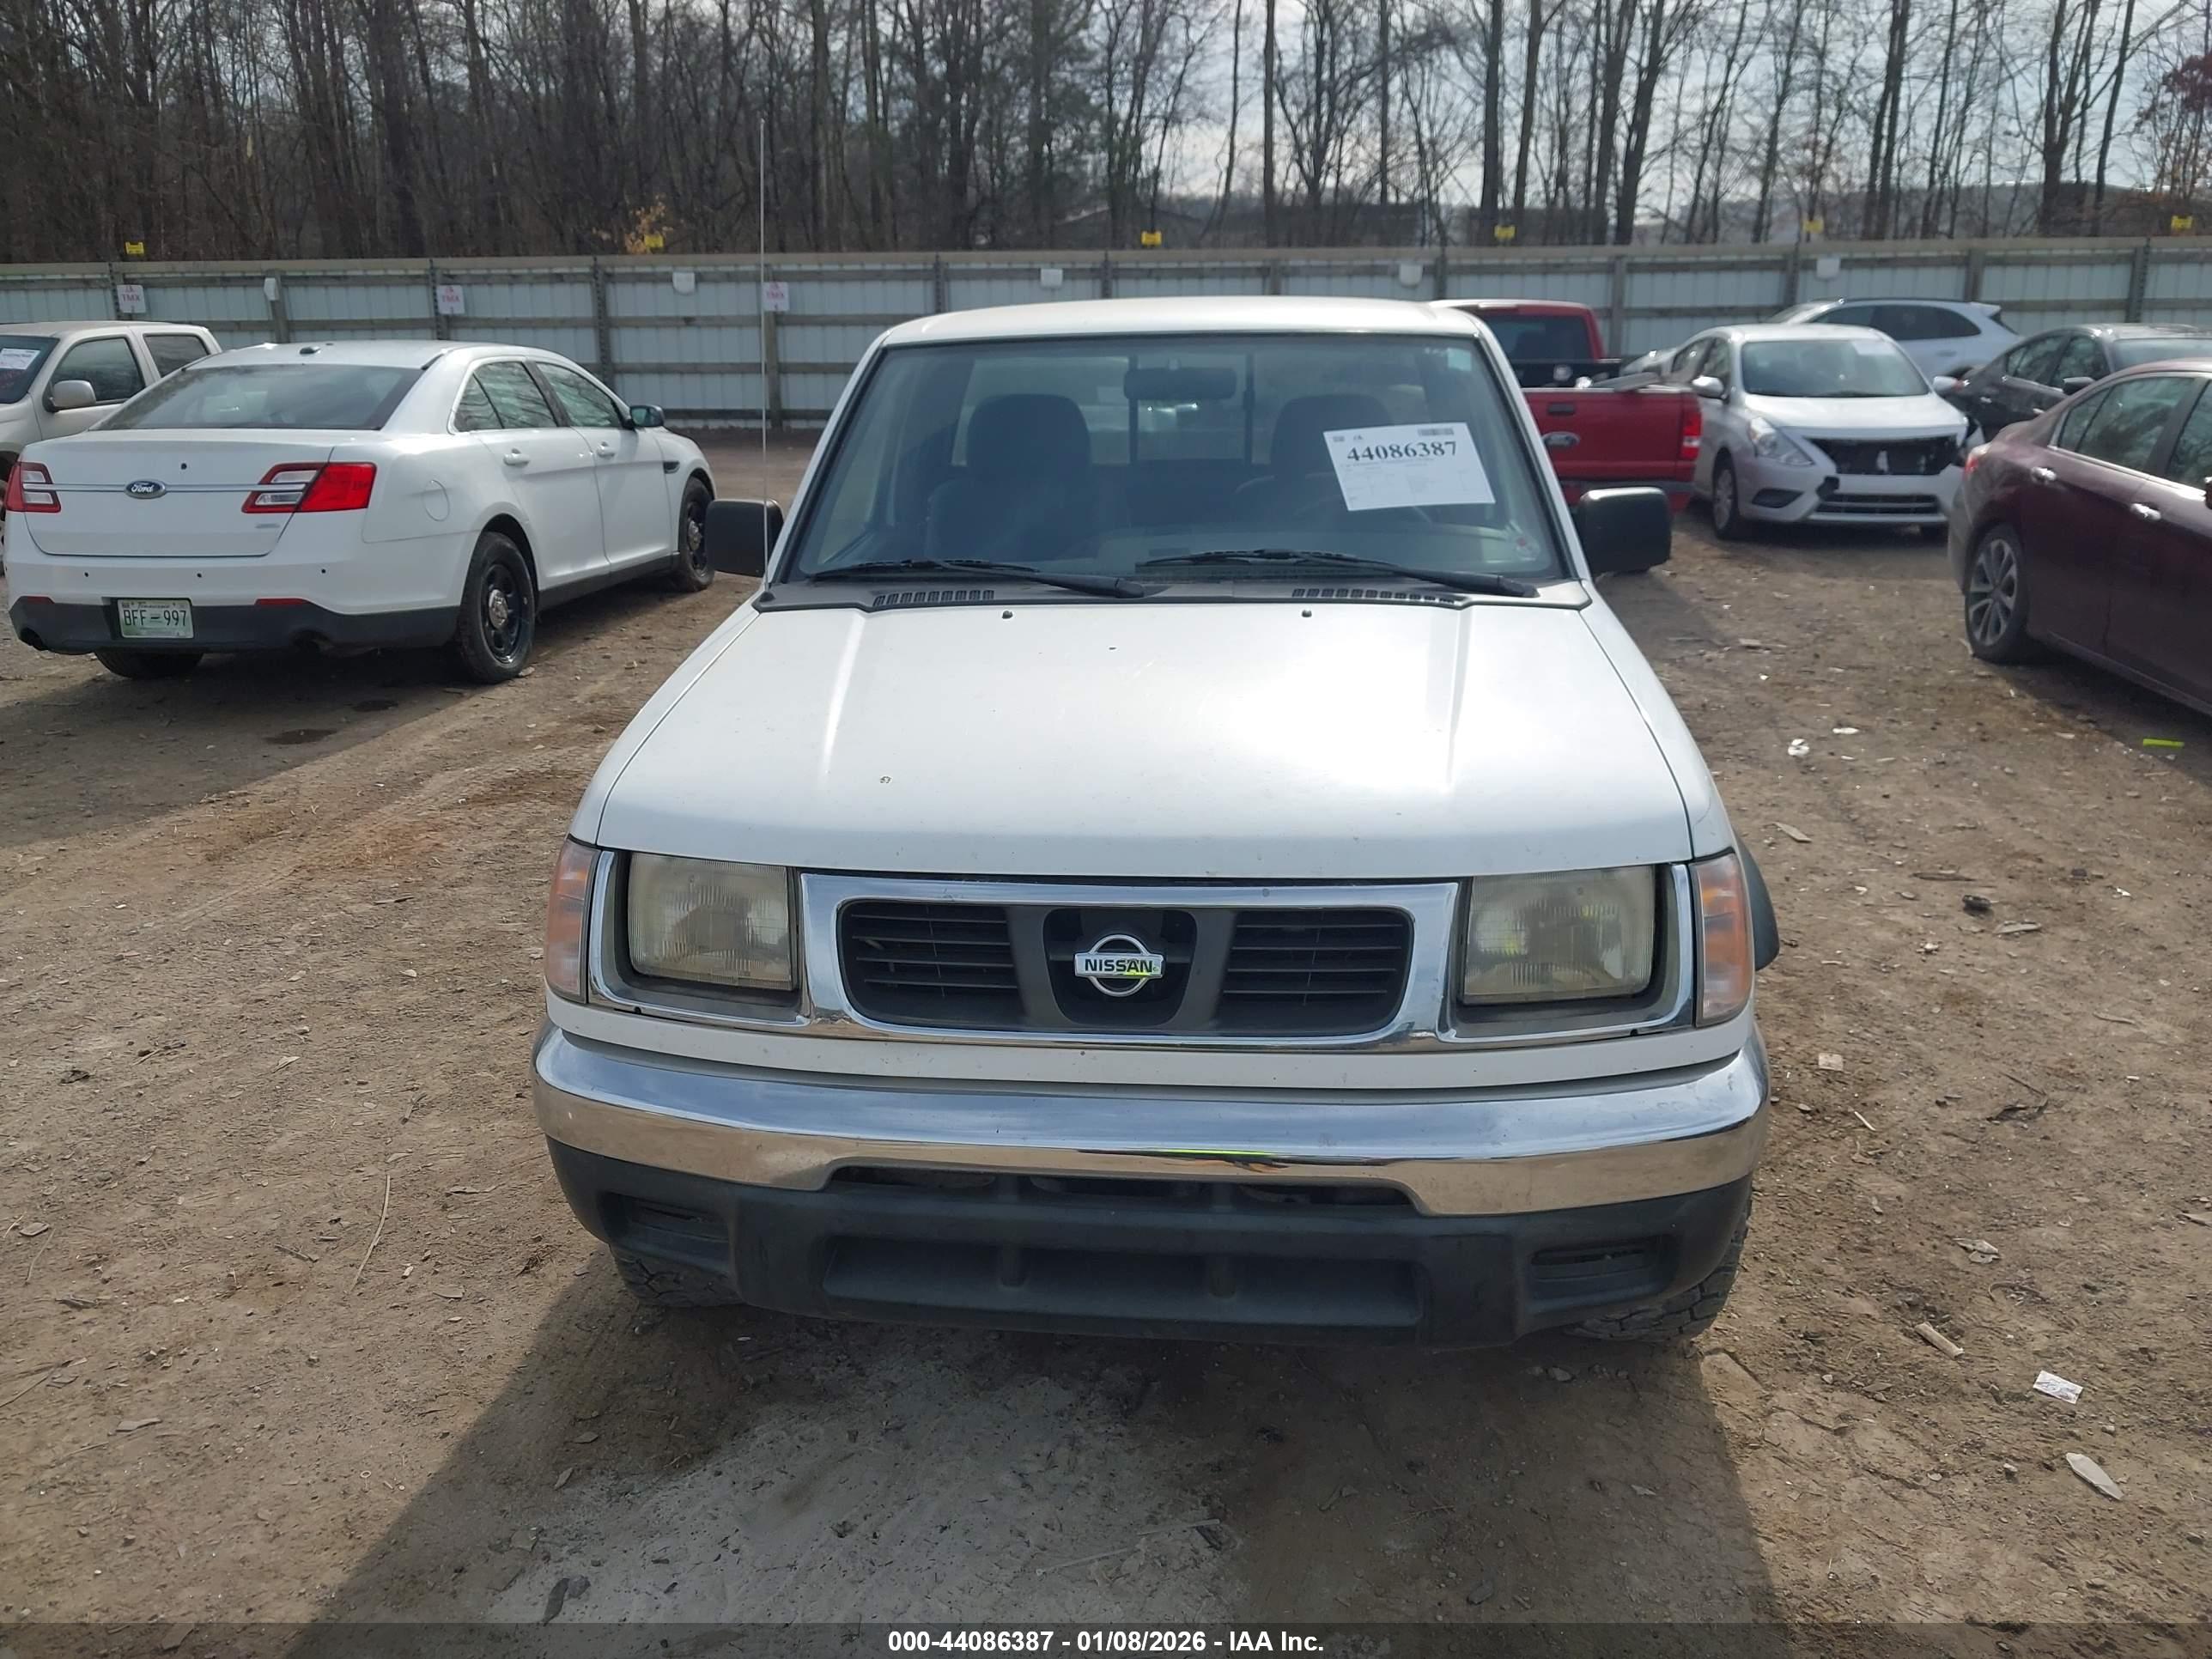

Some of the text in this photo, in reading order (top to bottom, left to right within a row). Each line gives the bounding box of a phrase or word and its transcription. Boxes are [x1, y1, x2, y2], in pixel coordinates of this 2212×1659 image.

[1347, 441, 1456, 462] 44086387
[131, 483, 155, 493] Ford
[1085, 958, 1153, 973] NISSAN
